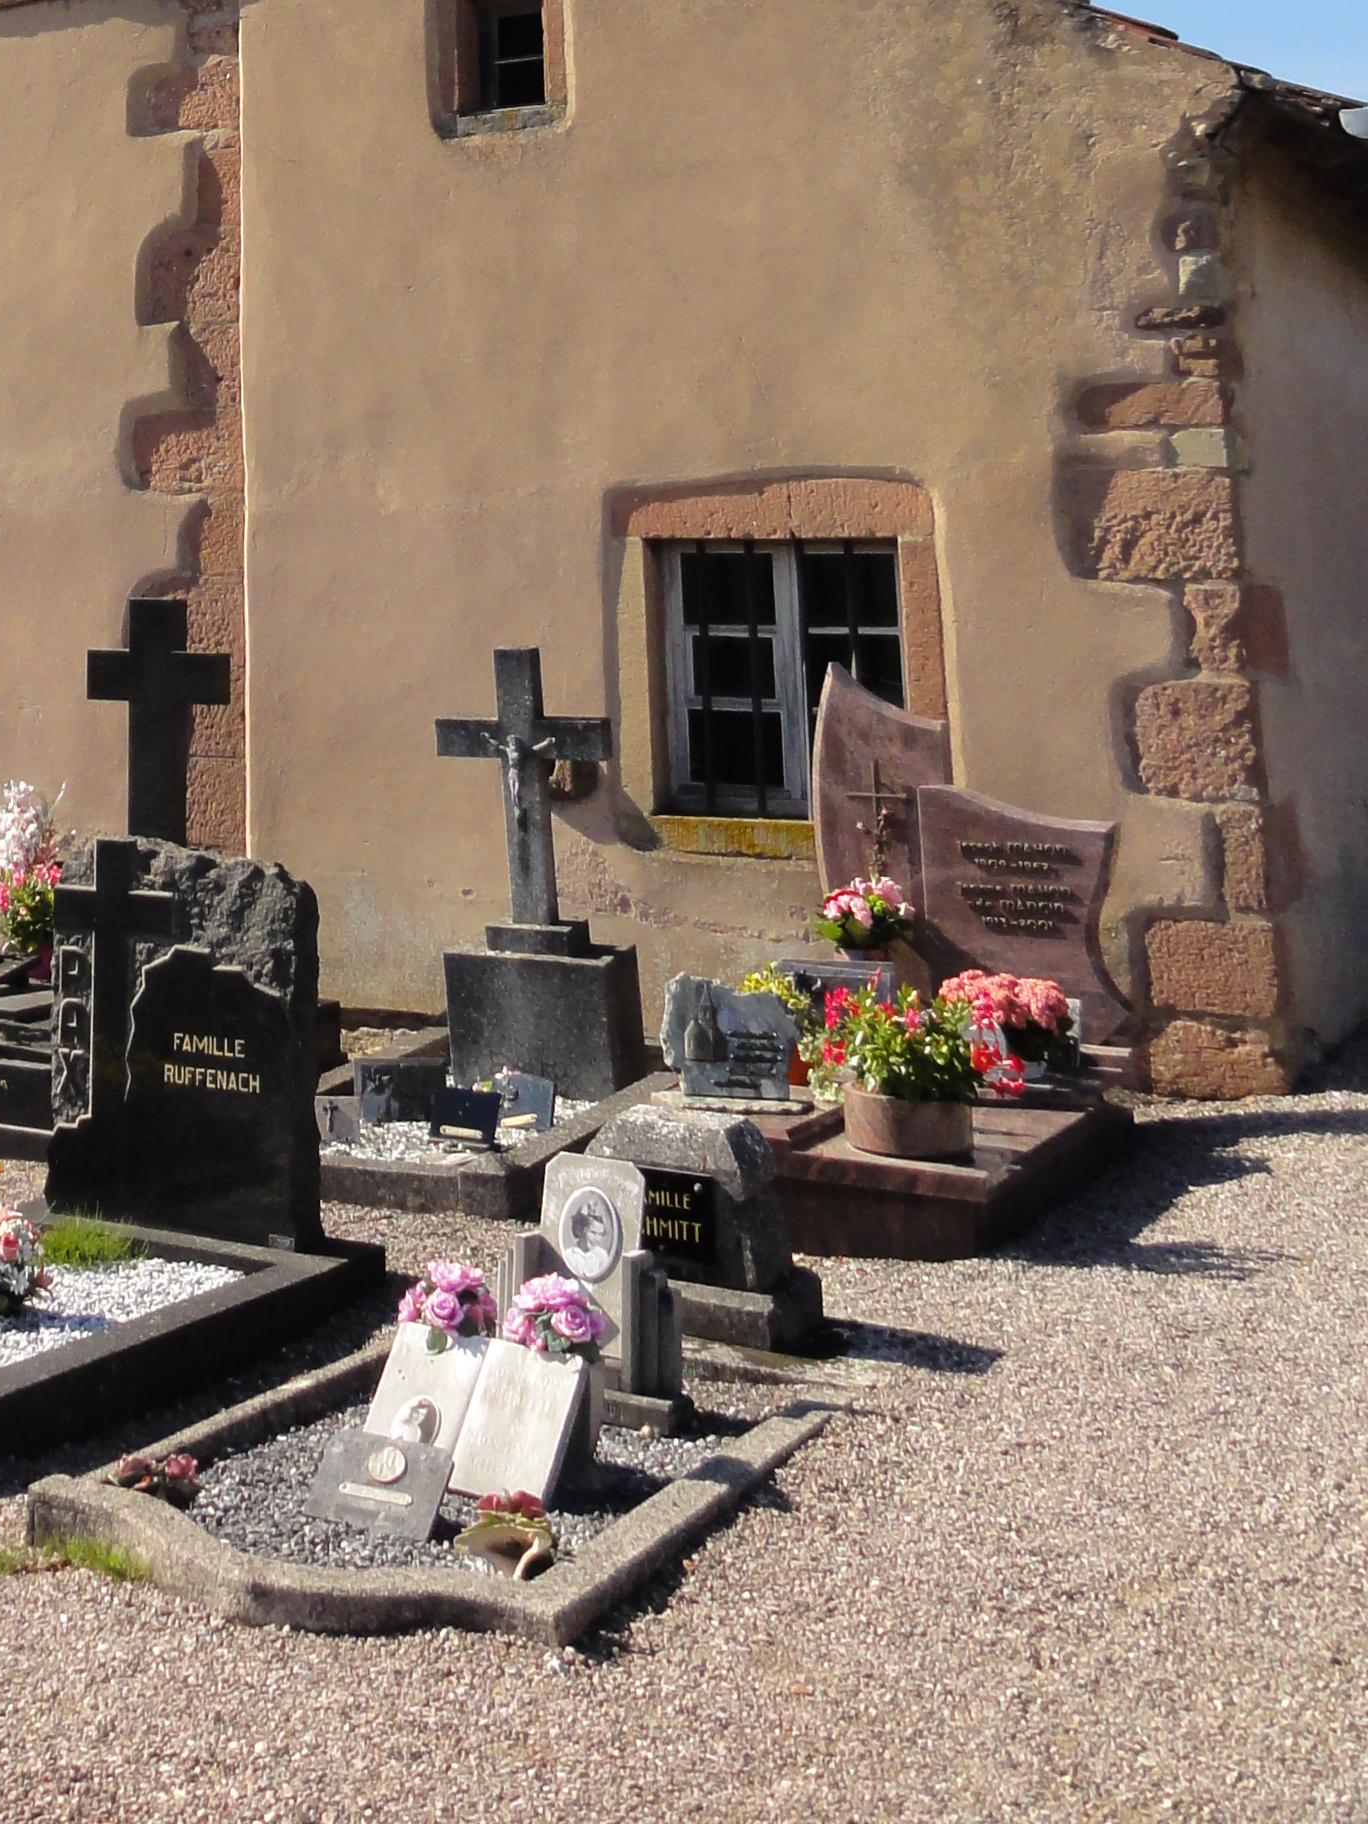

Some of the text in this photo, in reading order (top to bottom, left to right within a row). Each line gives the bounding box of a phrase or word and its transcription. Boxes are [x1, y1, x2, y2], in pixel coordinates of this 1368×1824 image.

[173, 1032, 246, 1059] FAMILLE
[163, 1063, 260, 1094] RUFFENACH
[643, 1189, 692, 1211] MILLE
[642, 1217, 703, 1244] HMITT
